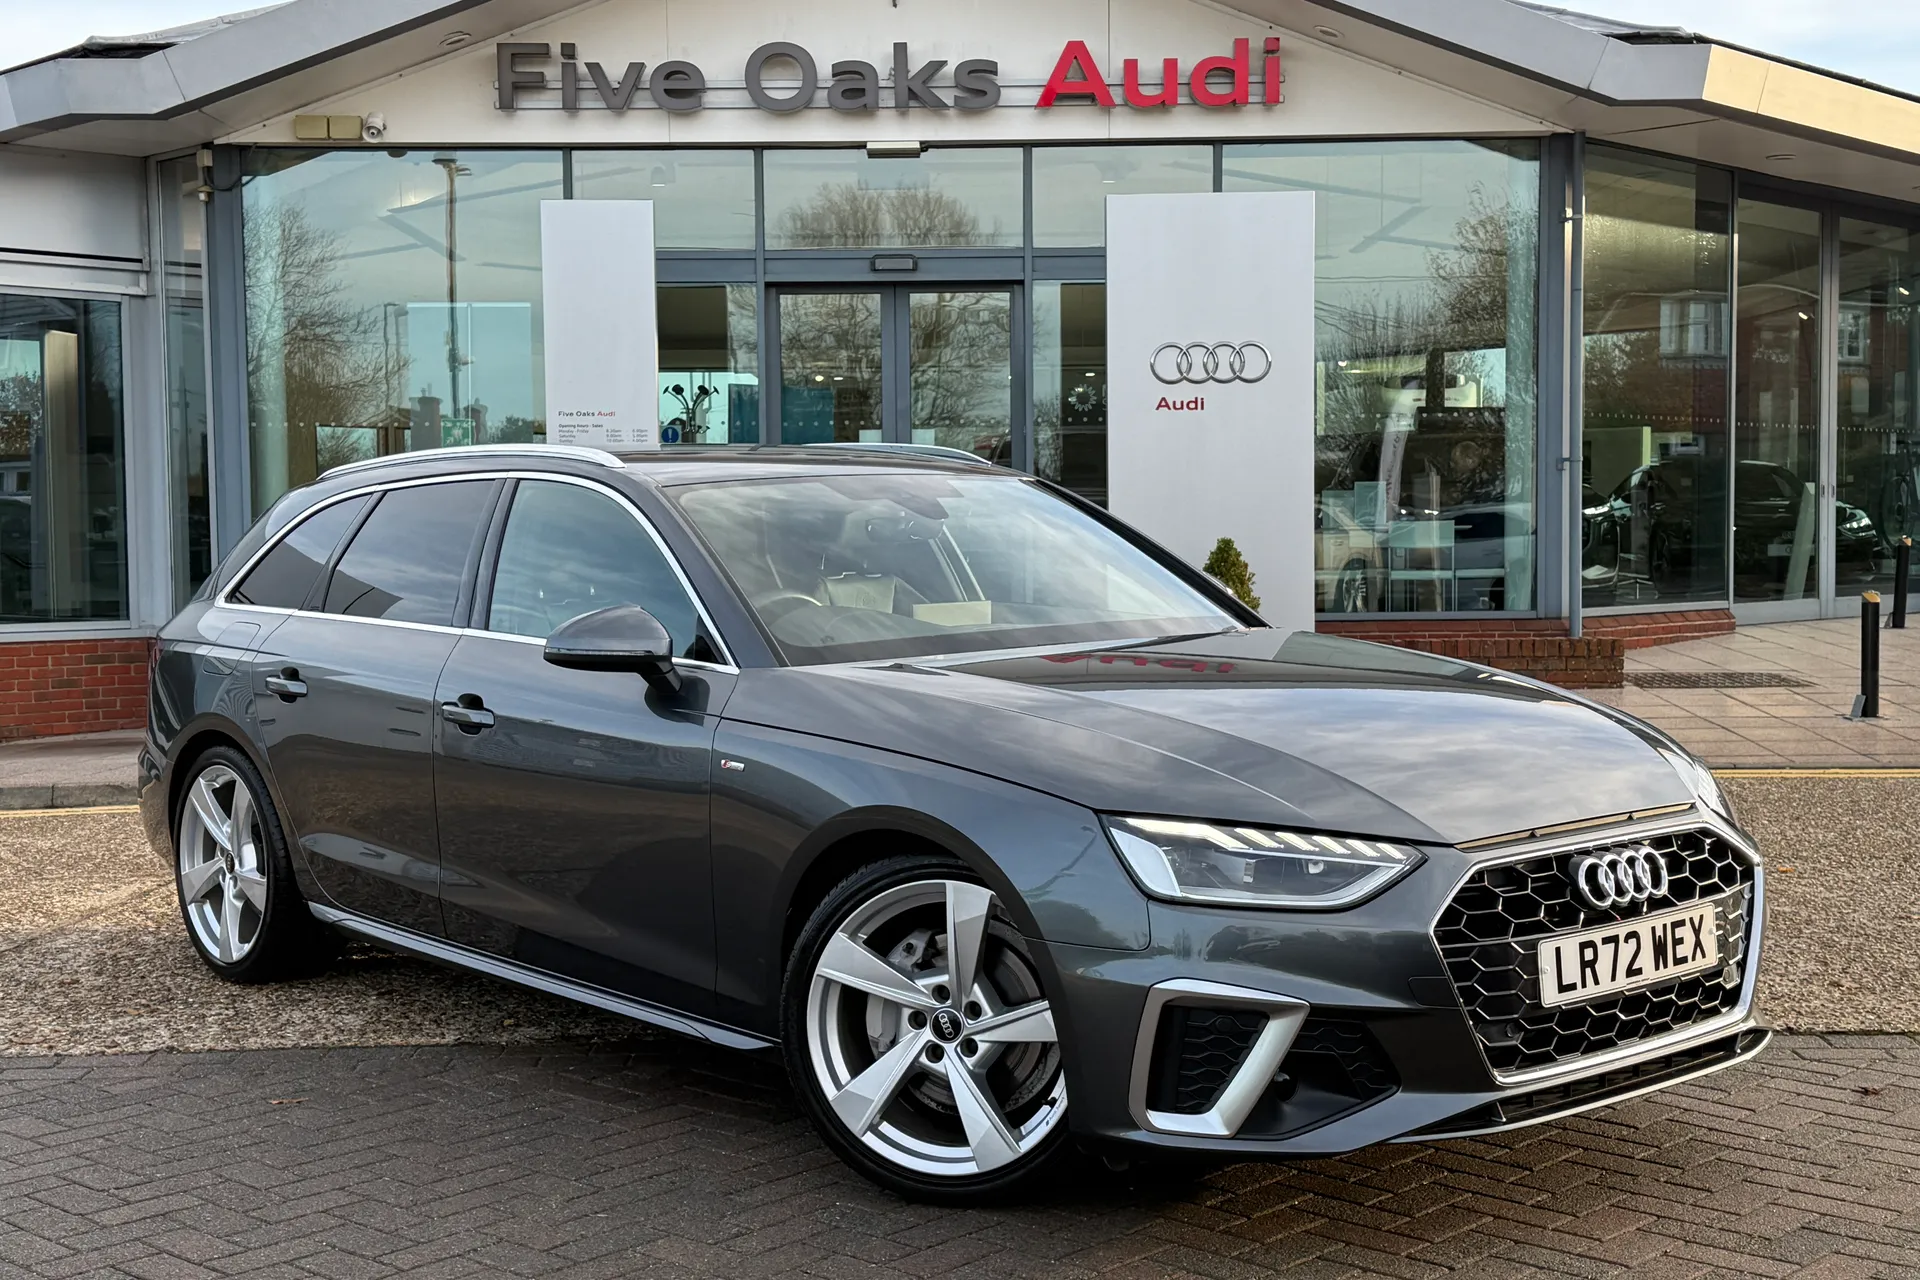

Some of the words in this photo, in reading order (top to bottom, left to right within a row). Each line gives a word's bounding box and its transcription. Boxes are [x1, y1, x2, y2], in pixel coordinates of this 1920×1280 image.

[496, 42, 706, 112] Five
[744, 41, 1000, 112] Oaks
[1033, 37, 1281, 109] Audi
[1155, 396, 1205, 411] Audi
[1554, 930, 1644, 995] LR72
[1650, 913, 1707, 972] WEX
